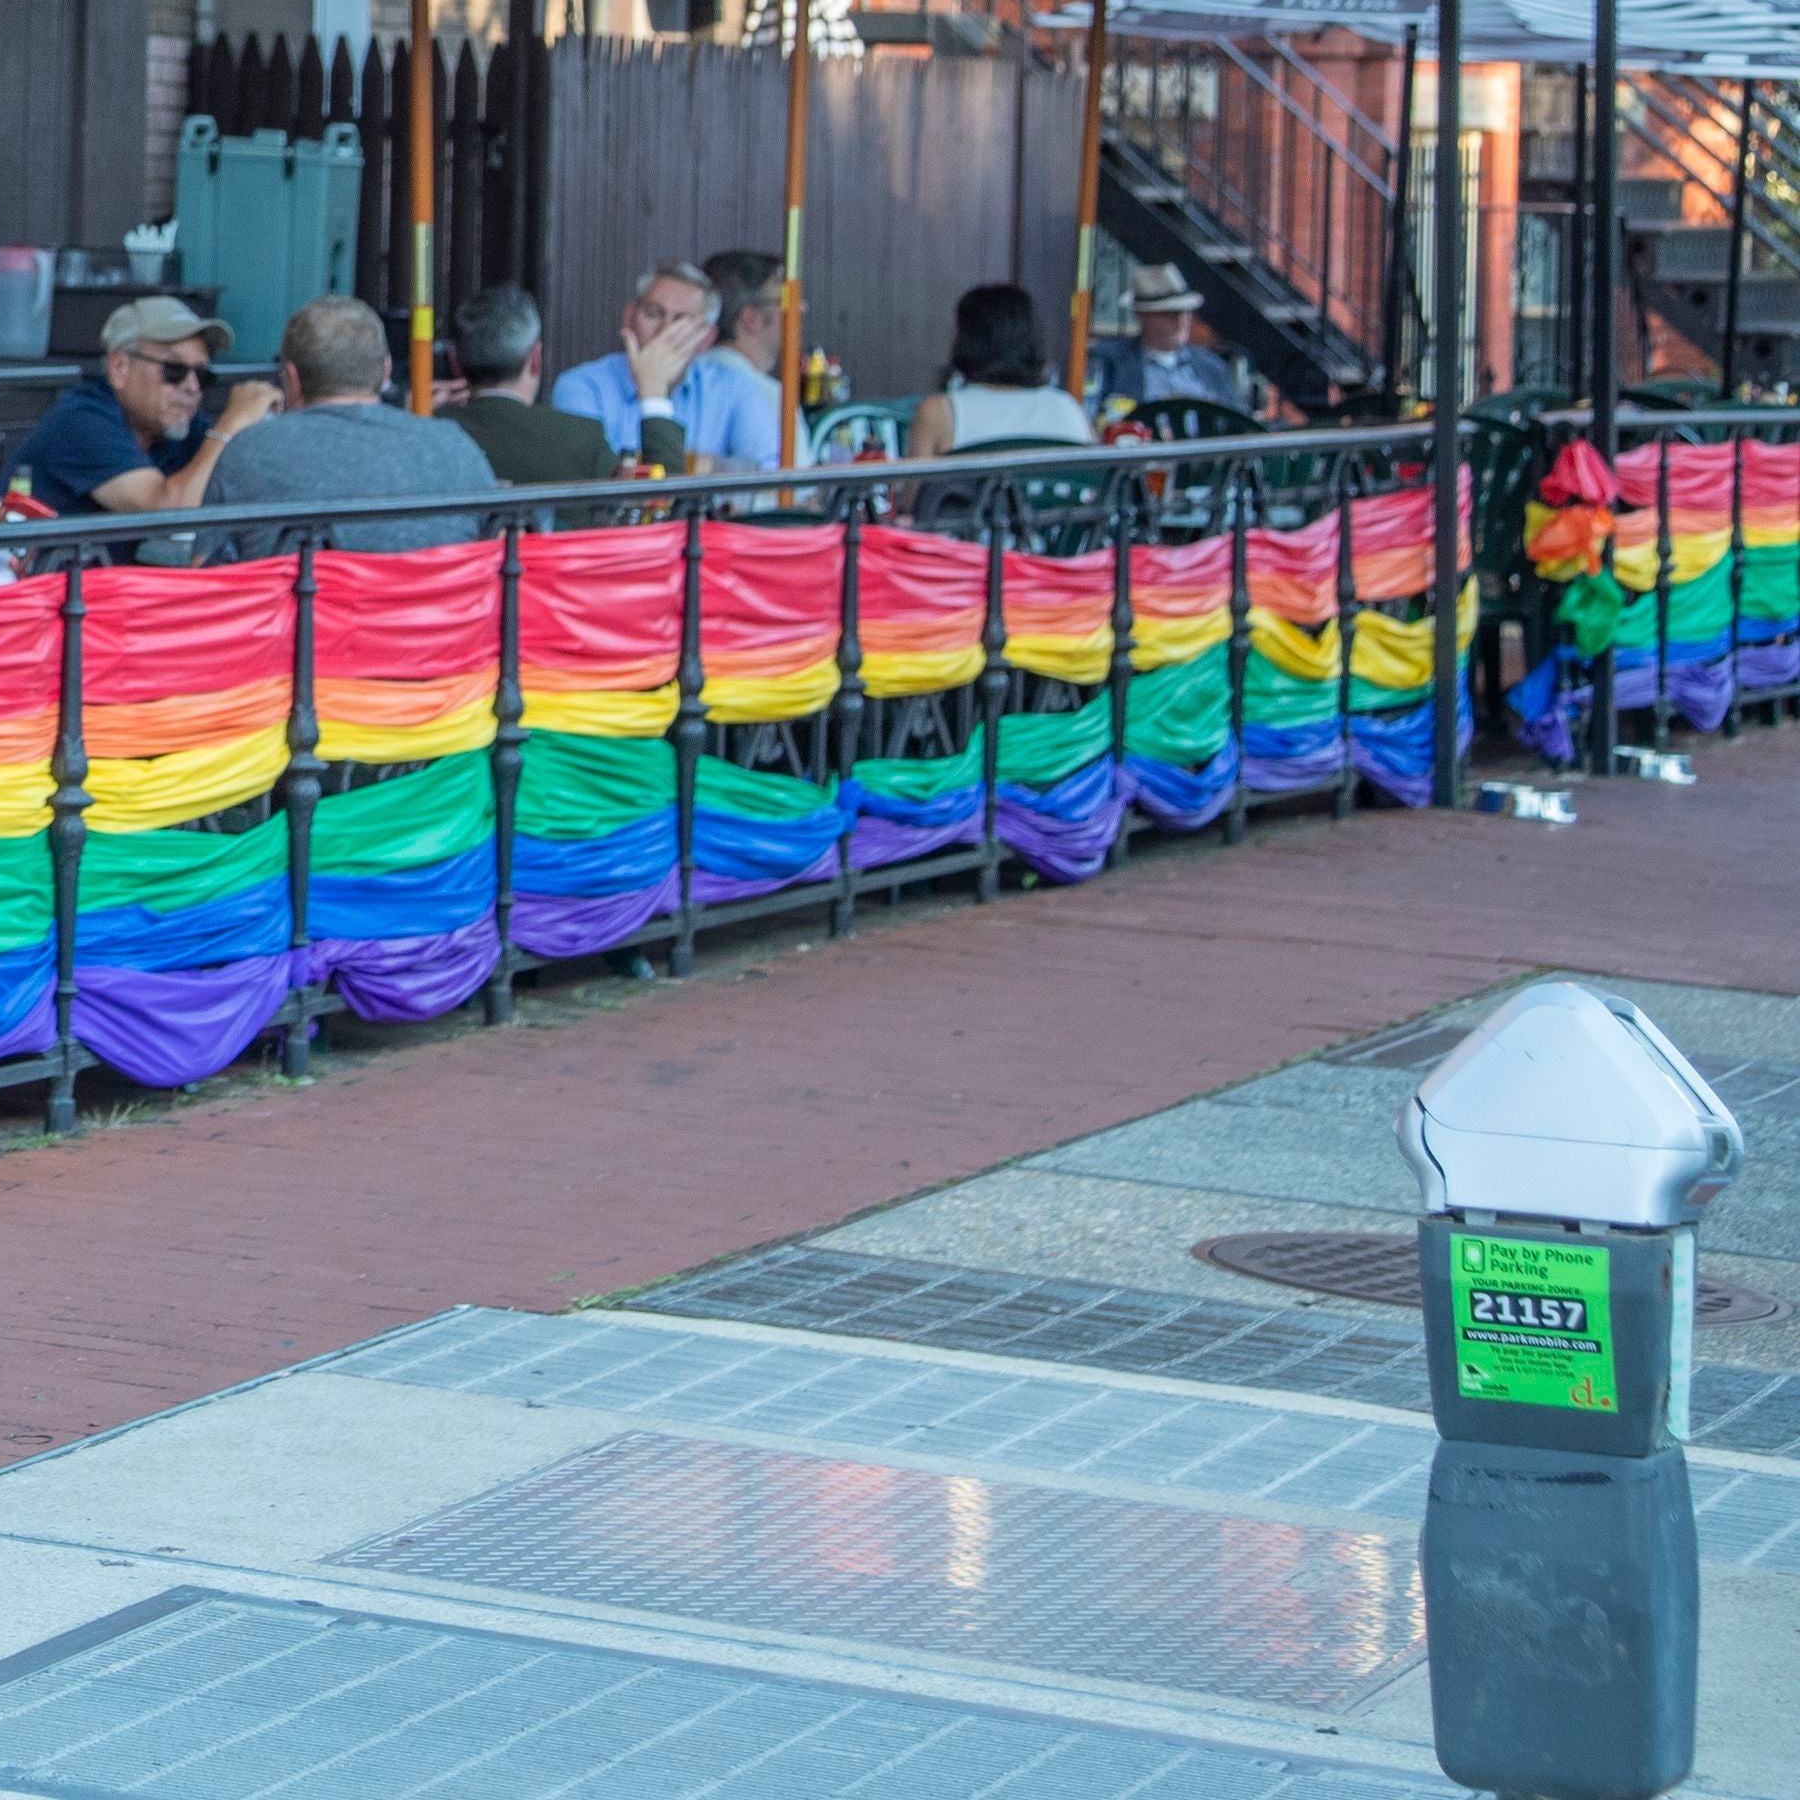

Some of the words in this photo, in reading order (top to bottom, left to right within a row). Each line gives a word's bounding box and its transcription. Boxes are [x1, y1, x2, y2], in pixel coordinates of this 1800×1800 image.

[1490, 1244, 1515, 1260] Pay
[1522, 1246, 1540, 1262] by
[1545, 1248, 1594, 1266] Phone
[1490, 1259, 1548, 1280] Parking
[1471, 1277, 1499, 1289] YOUR
[1501, 1280, 1546, 1293] PARKING
[1472, 1291, 1584, 1330] 21157
[1466, 1328, 1598, 1352] www.parkmobile.com
